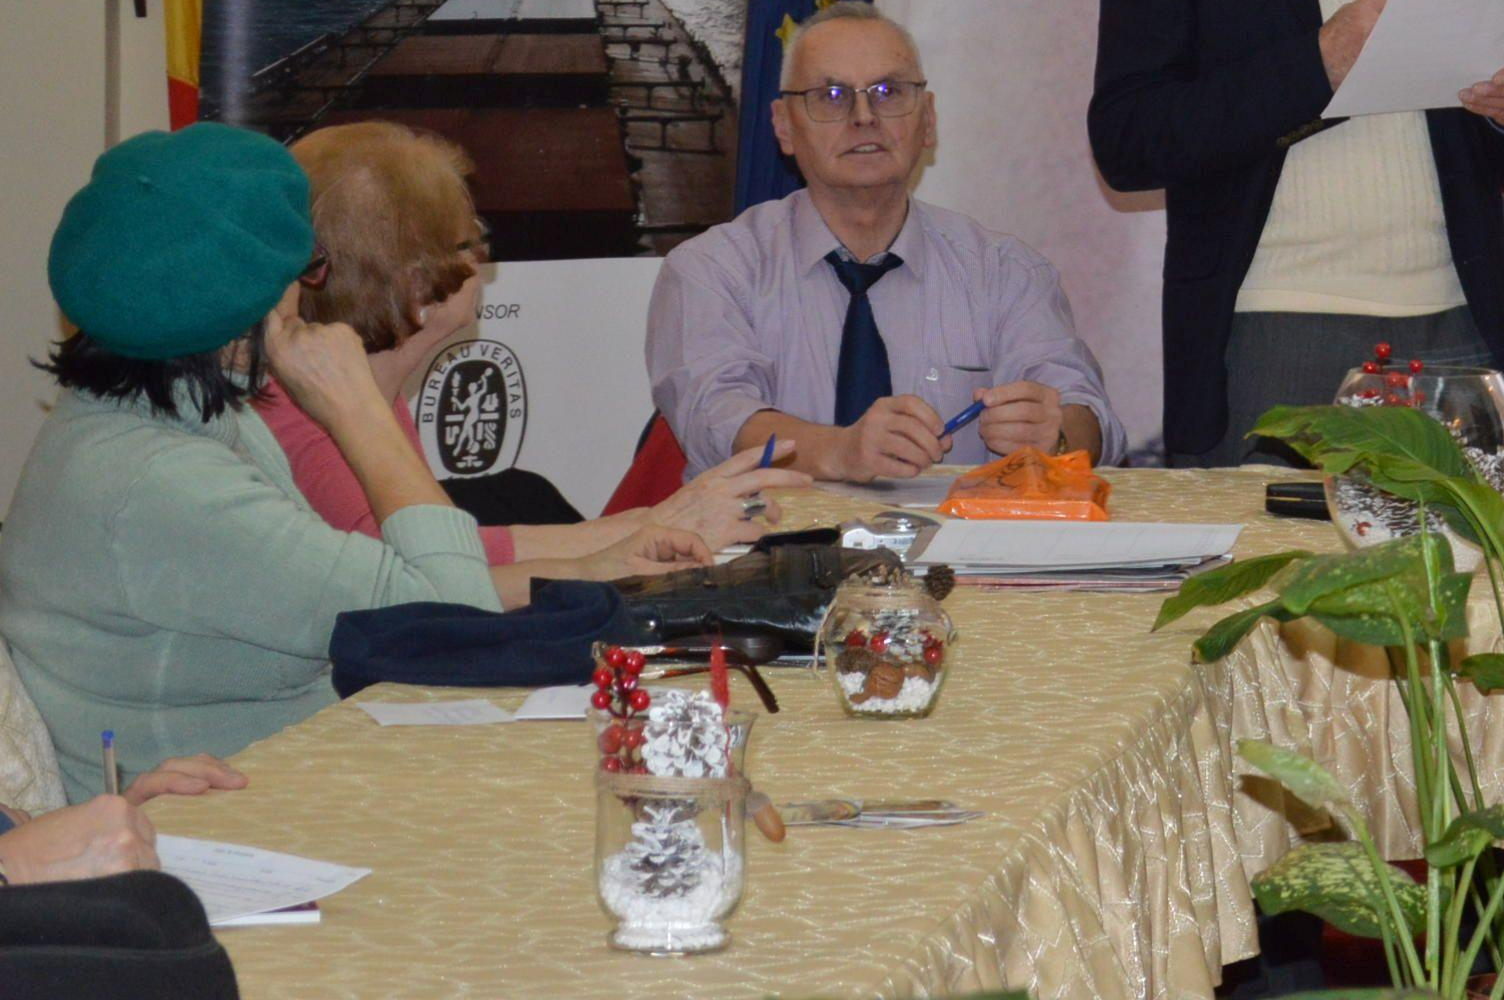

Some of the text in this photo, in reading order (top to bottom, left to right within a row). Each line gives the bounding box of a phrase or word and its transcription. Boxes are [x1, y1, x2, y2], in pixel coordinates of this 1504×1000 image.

[475, 304, 521, 320] NSOR
[423, 344, 521, 423] BUREAU VERITAS
